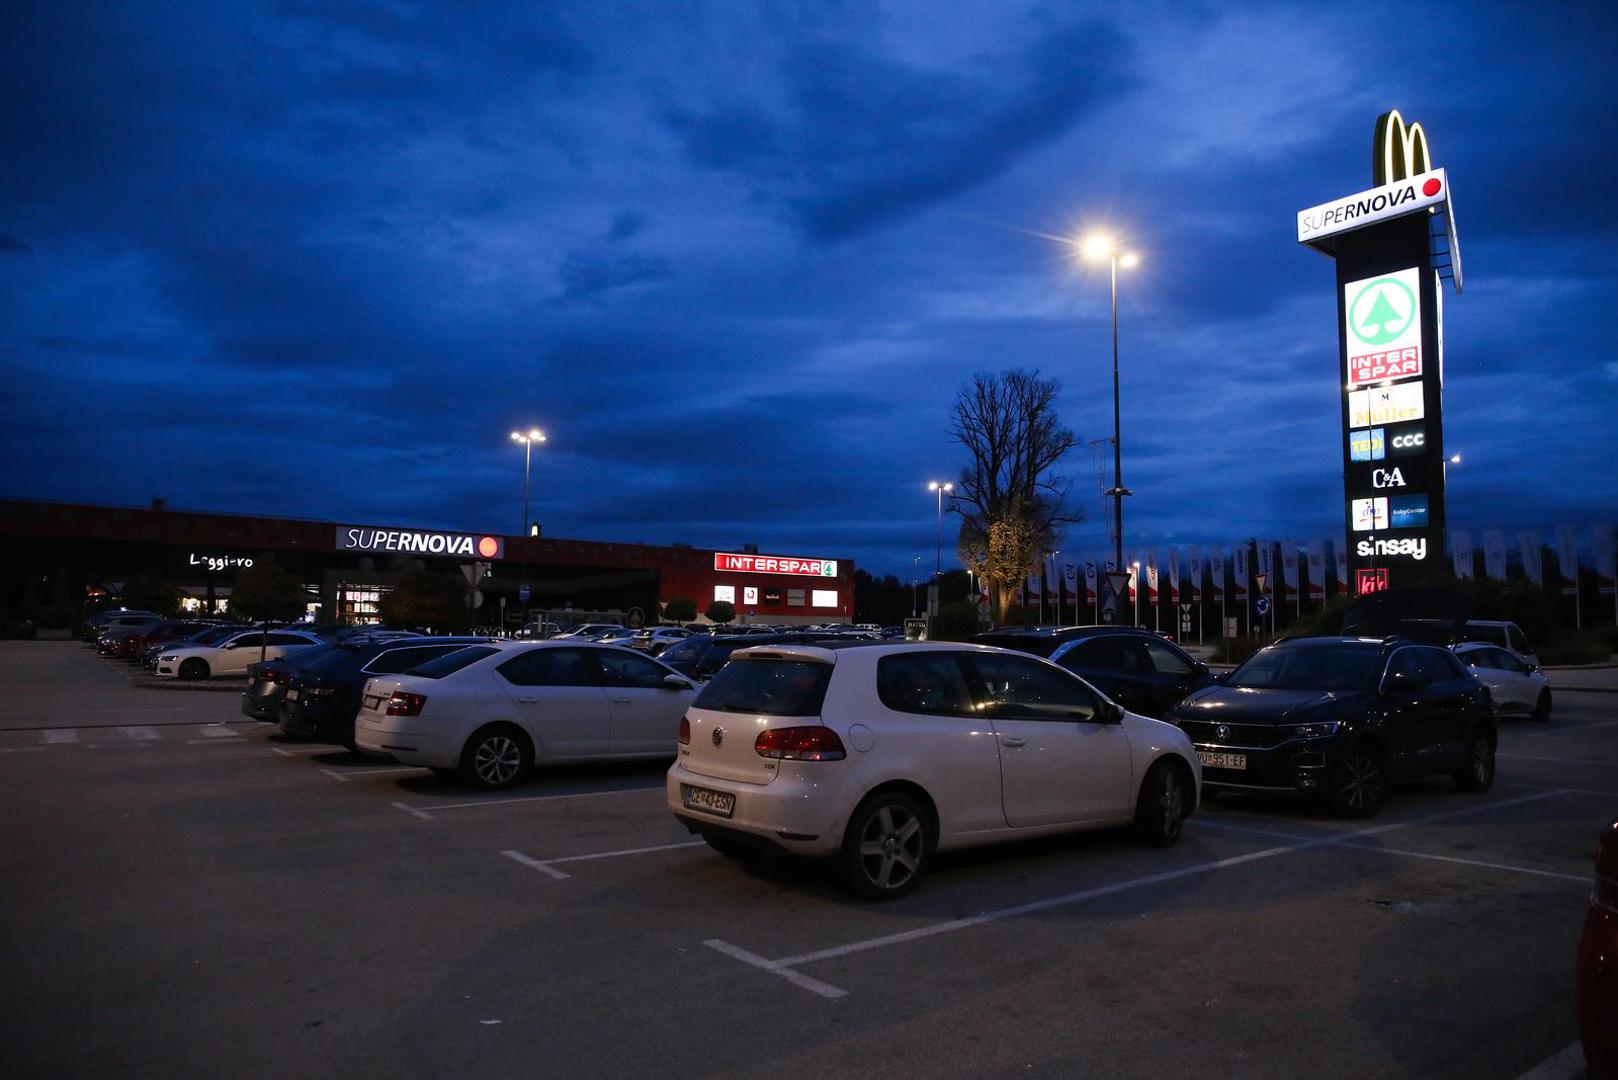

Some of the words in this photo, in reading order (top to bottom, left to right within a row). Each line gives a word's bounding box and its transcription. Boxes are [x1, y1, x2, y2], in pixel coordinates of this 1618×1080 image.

[1302, 185, 1417, 234] SUPERNOVA
[1352, 347, 1417, 370] INTER
[1358, 360, 1417, 380] SPAR
[1392, 433, 1425, 449] CCC
[1372, 467, 1407, 488] C&A
[345, 529, 475, 555] SUPERNOVA
[1356, 535, 1427, 560] sinsay
[189, 553, 254, 571] Leggiero
[725, 556, 822, 574] INTERSPAR
